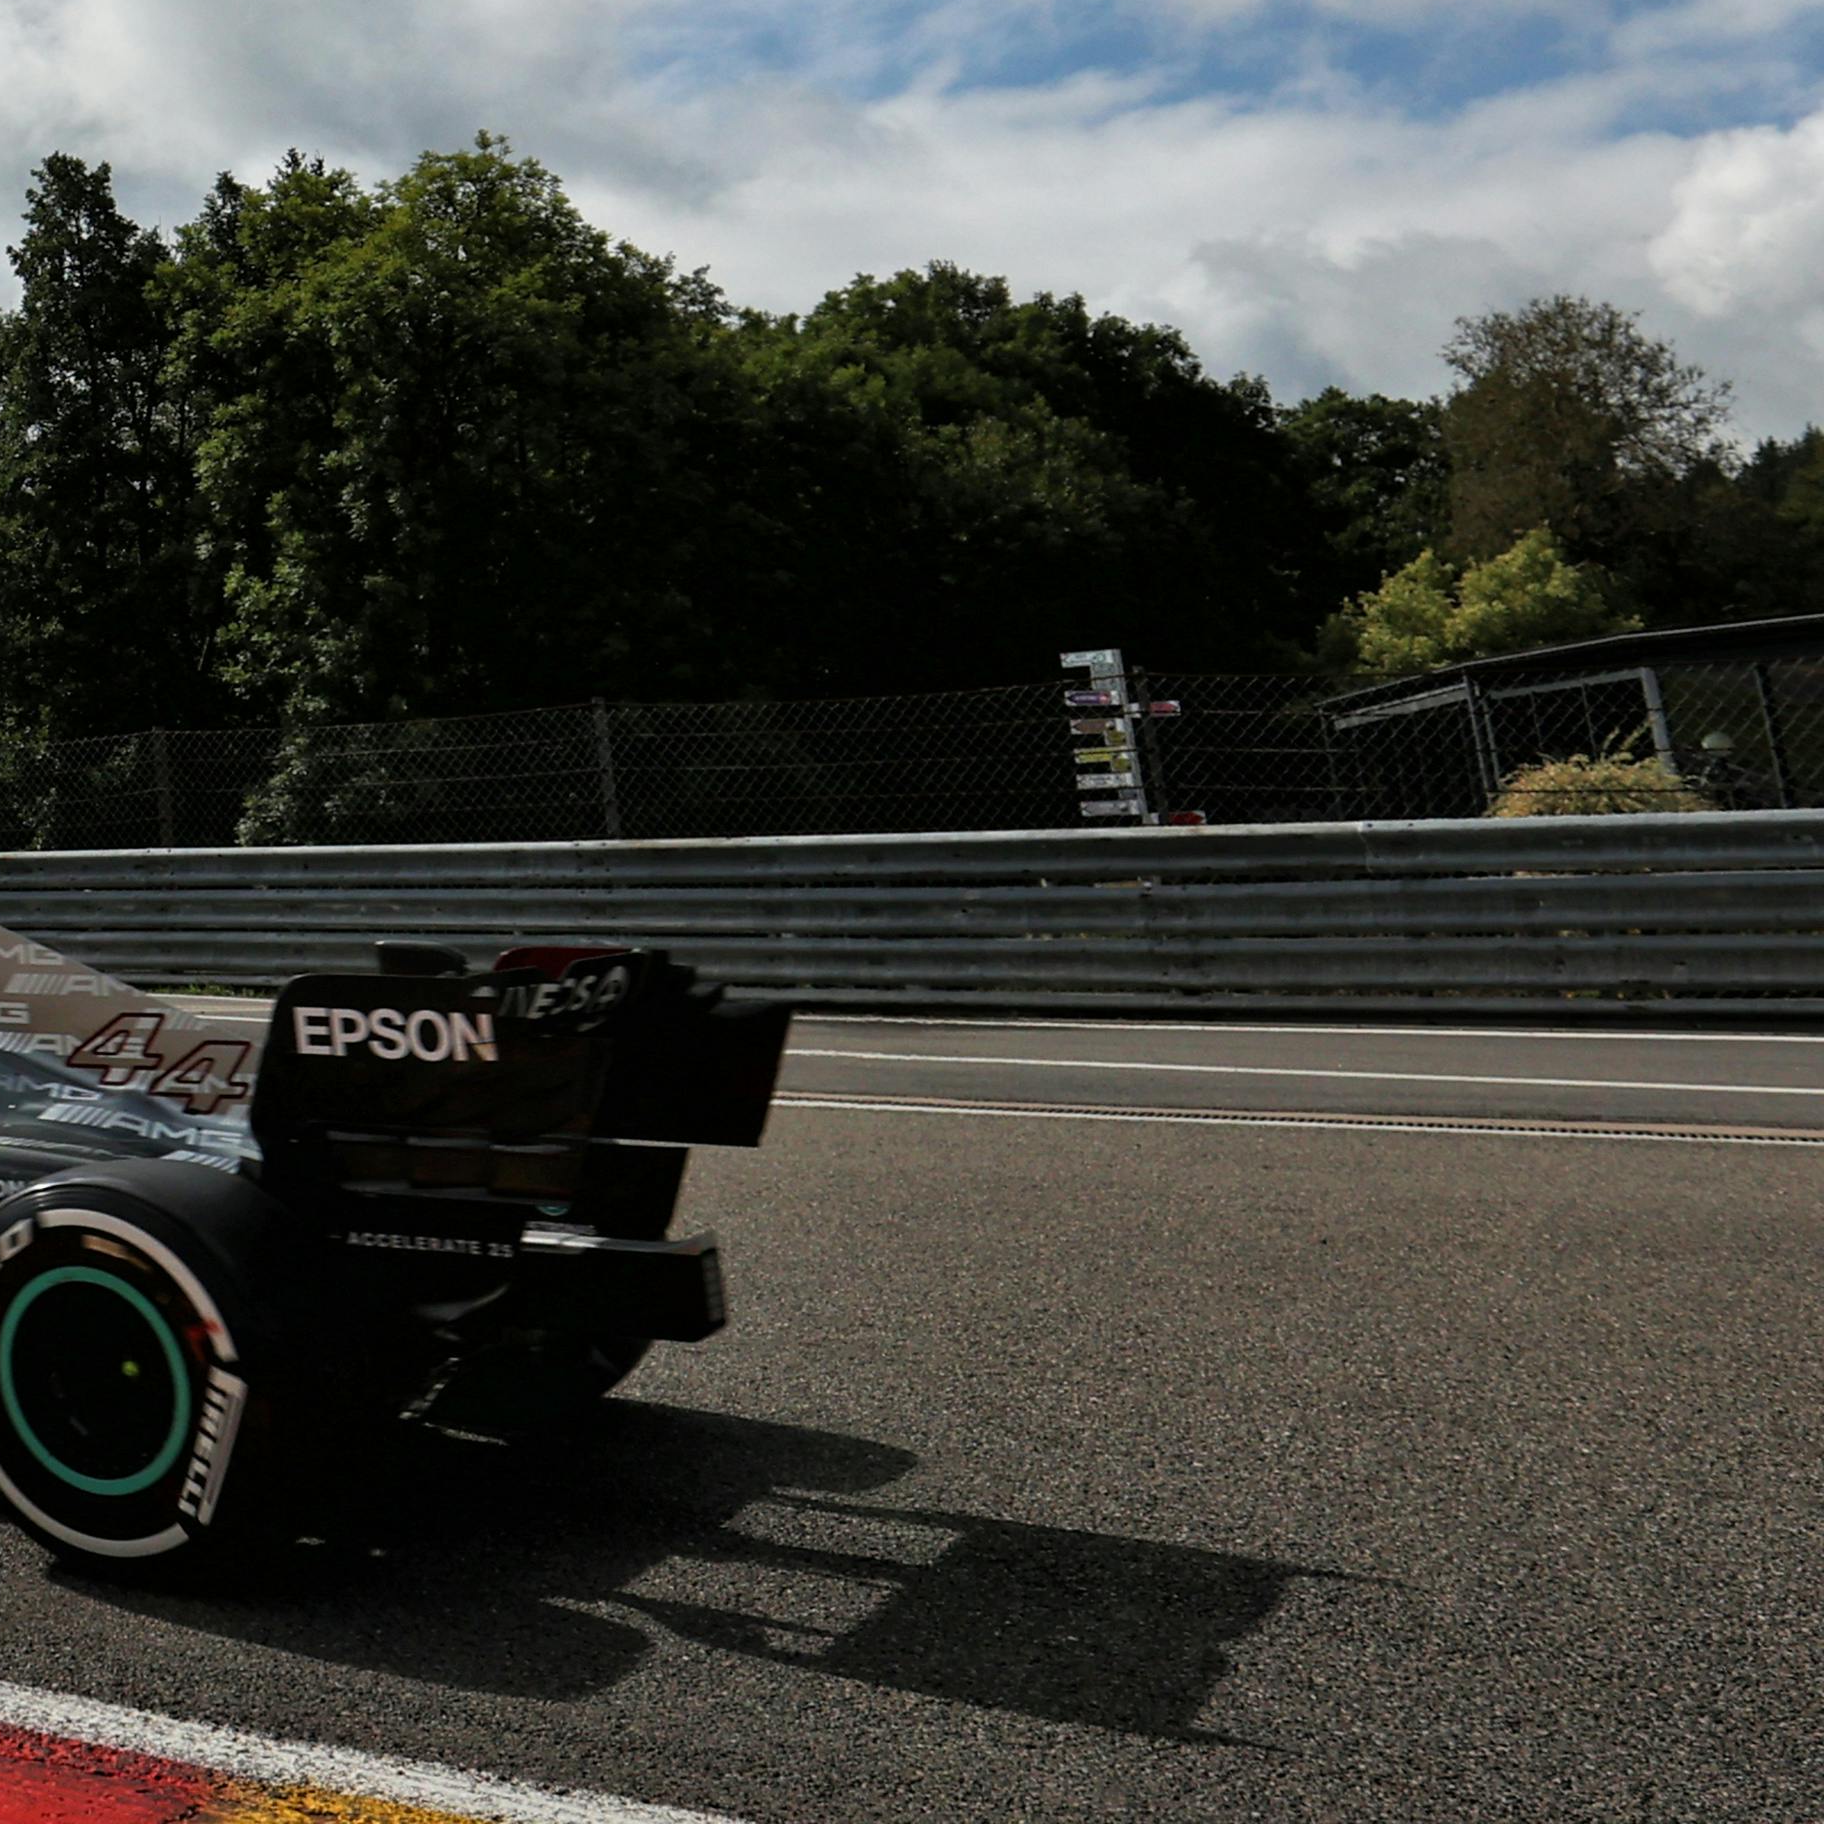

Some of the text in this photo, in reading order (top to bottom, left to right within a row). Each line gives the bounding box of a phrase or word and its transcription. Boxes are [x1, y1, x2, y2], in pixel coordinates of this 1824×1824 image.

[292, 1006, 499, 1062] EPSON
[66, 1013, 251, 1114] 44
[346, 1231, 514, 1259] ACCELERATE 25
